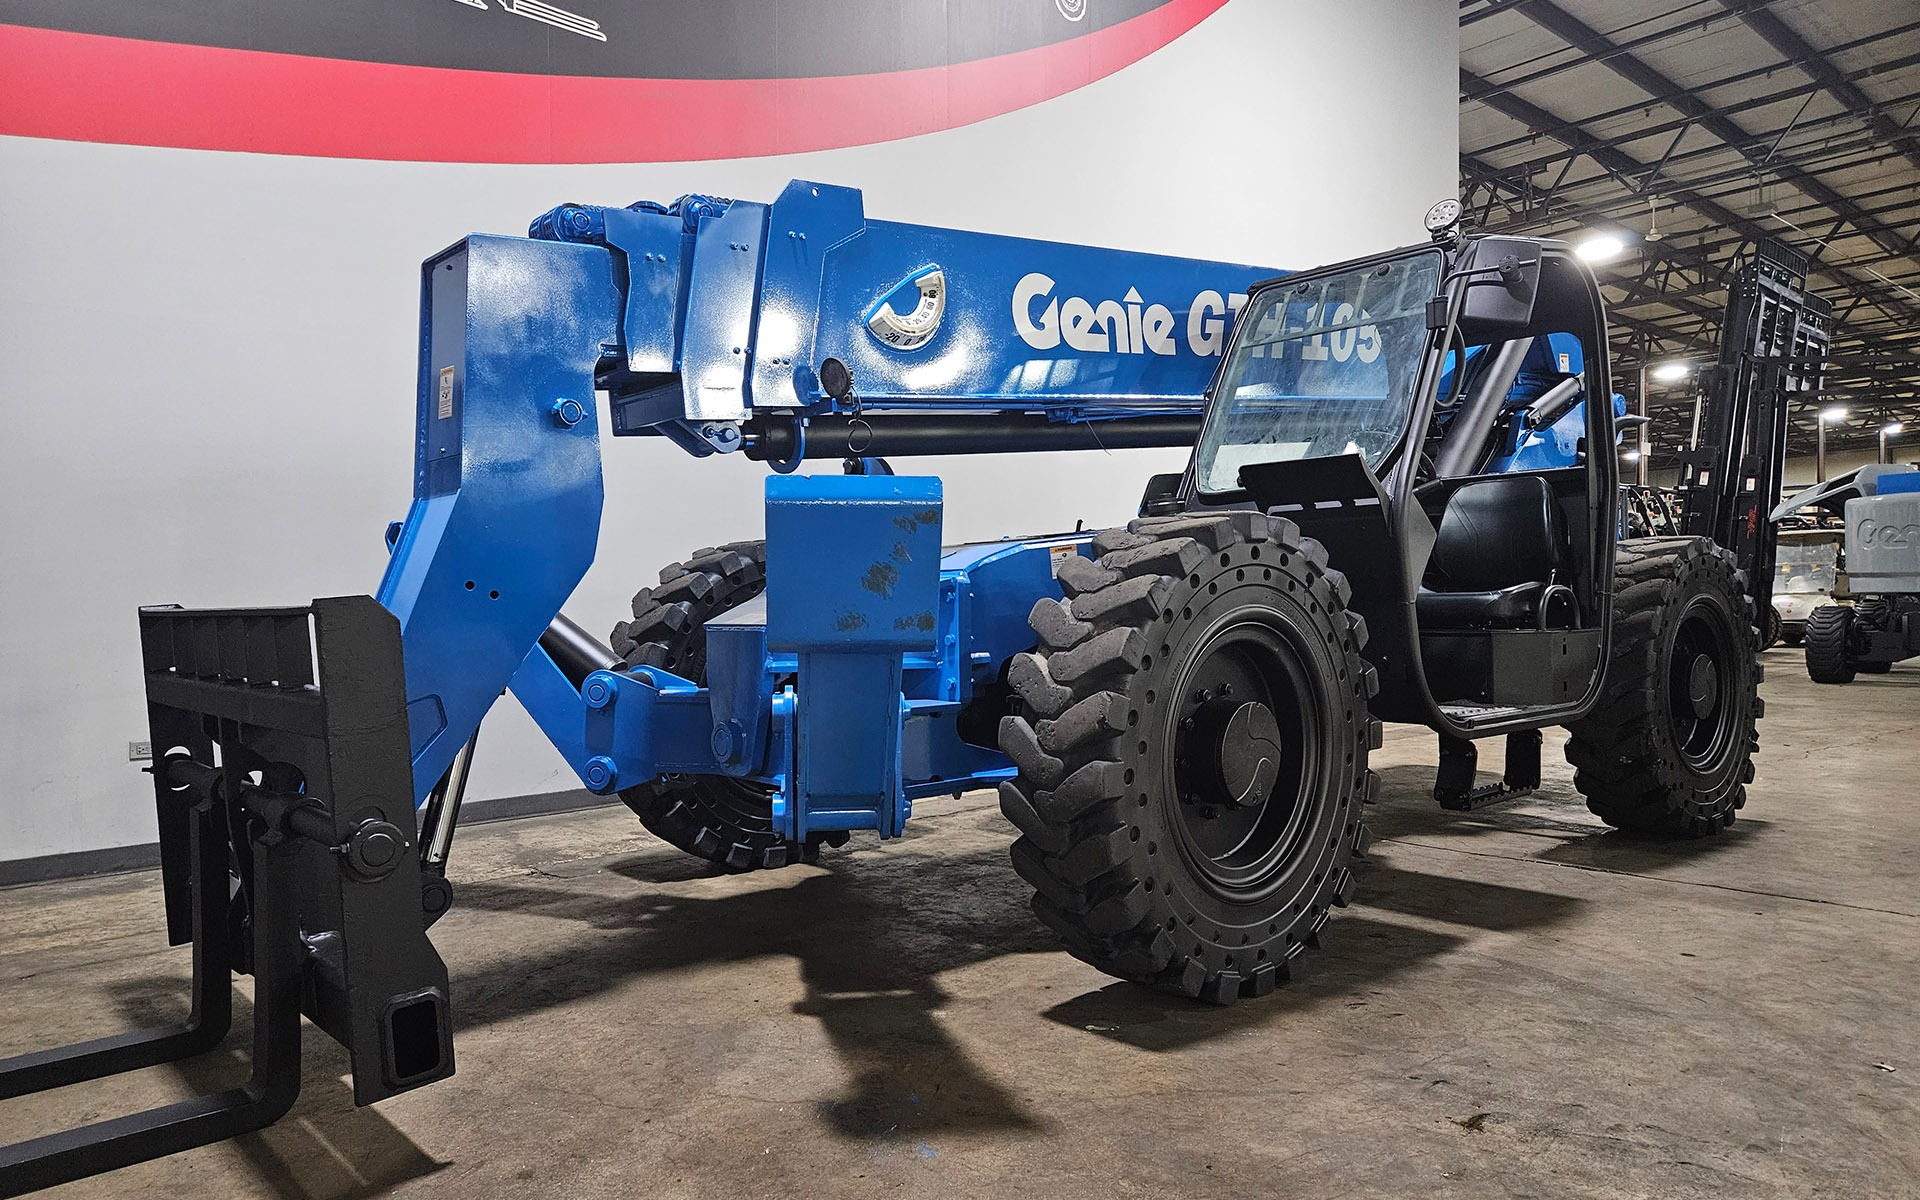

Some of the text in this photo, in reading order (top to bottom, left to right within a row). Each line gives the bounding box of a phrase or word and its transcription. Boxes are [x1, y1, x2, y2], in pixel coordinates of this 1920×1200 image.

[928, 289, 937, 299] 80
[926, 301, 935, 311] 60
[1011, 272, 1177, 356] Genie
[885, 332, 900, 343] -20
[903, 338, 912, 346] 0
